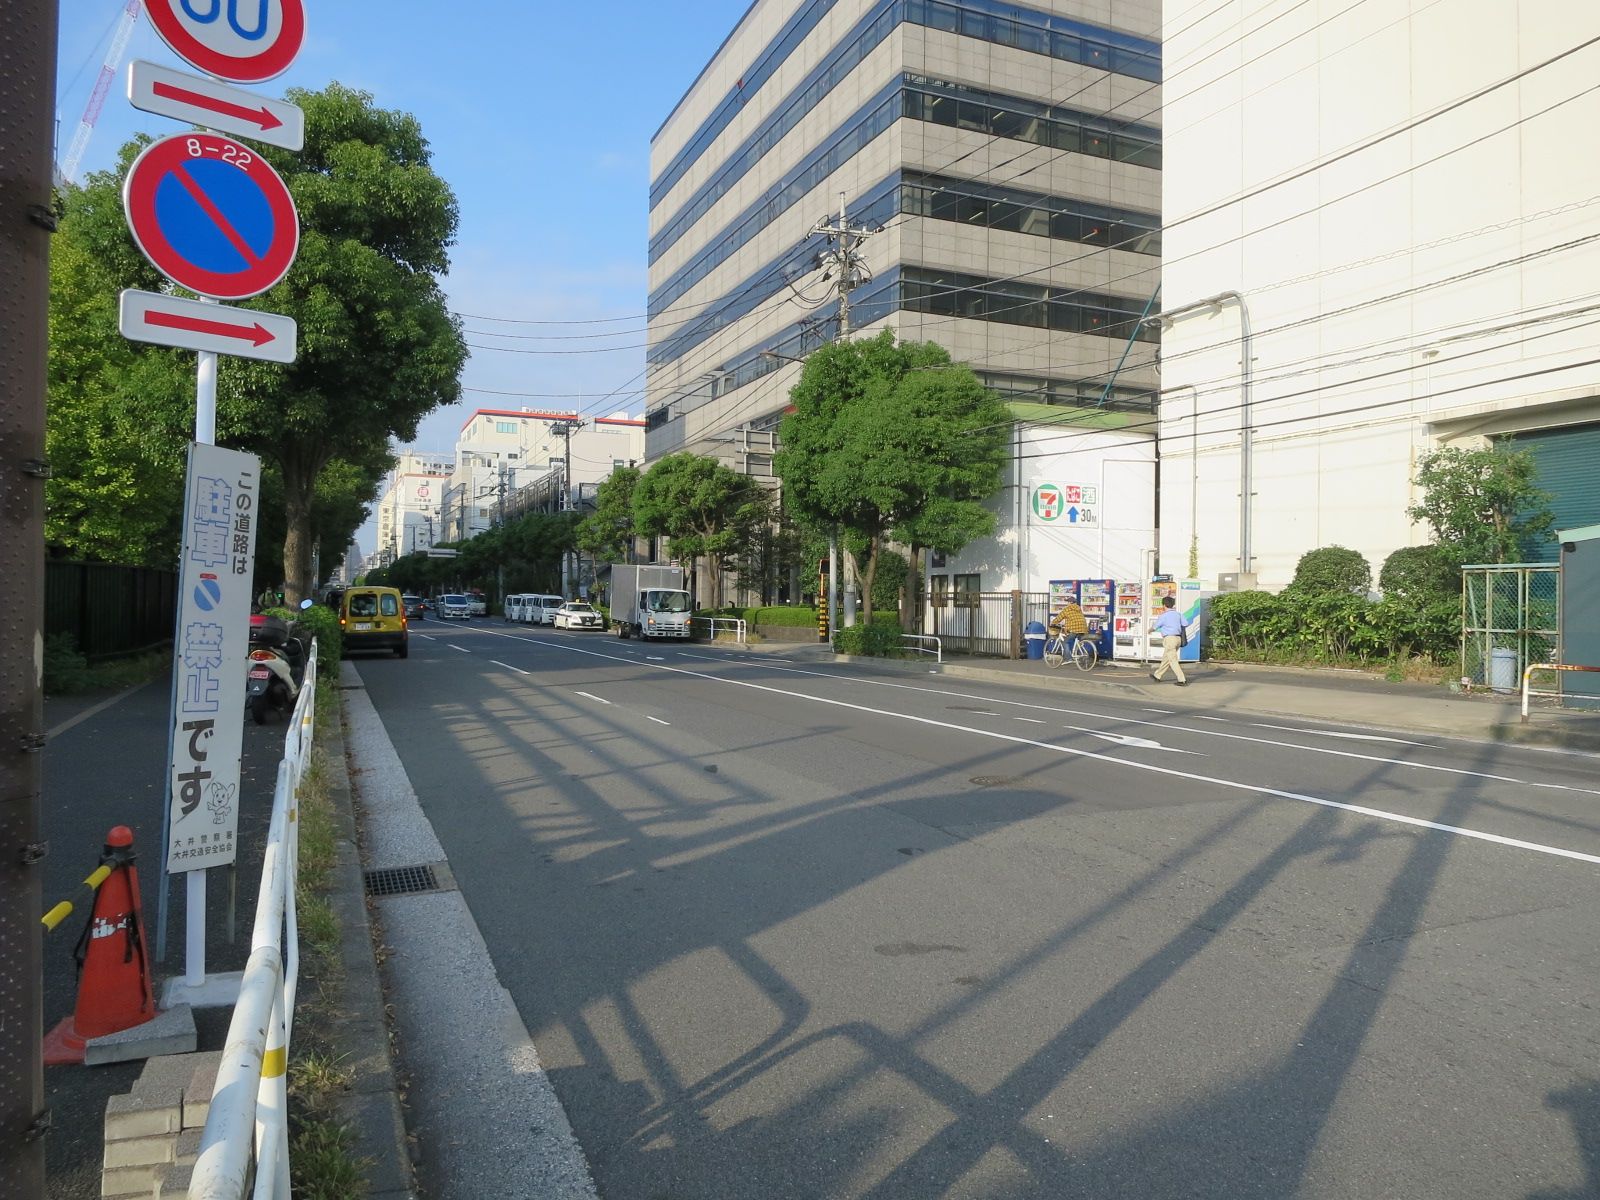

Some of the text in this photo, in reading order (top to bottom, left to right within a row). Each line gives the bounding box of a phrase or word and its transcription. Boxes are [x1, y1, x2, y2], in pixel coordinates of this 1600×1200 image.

[187, 138, 252, 172] 8-22
[232, 472, 253, 575] この道路は
[173, 842, 232, 859] 大井交通安全協会
